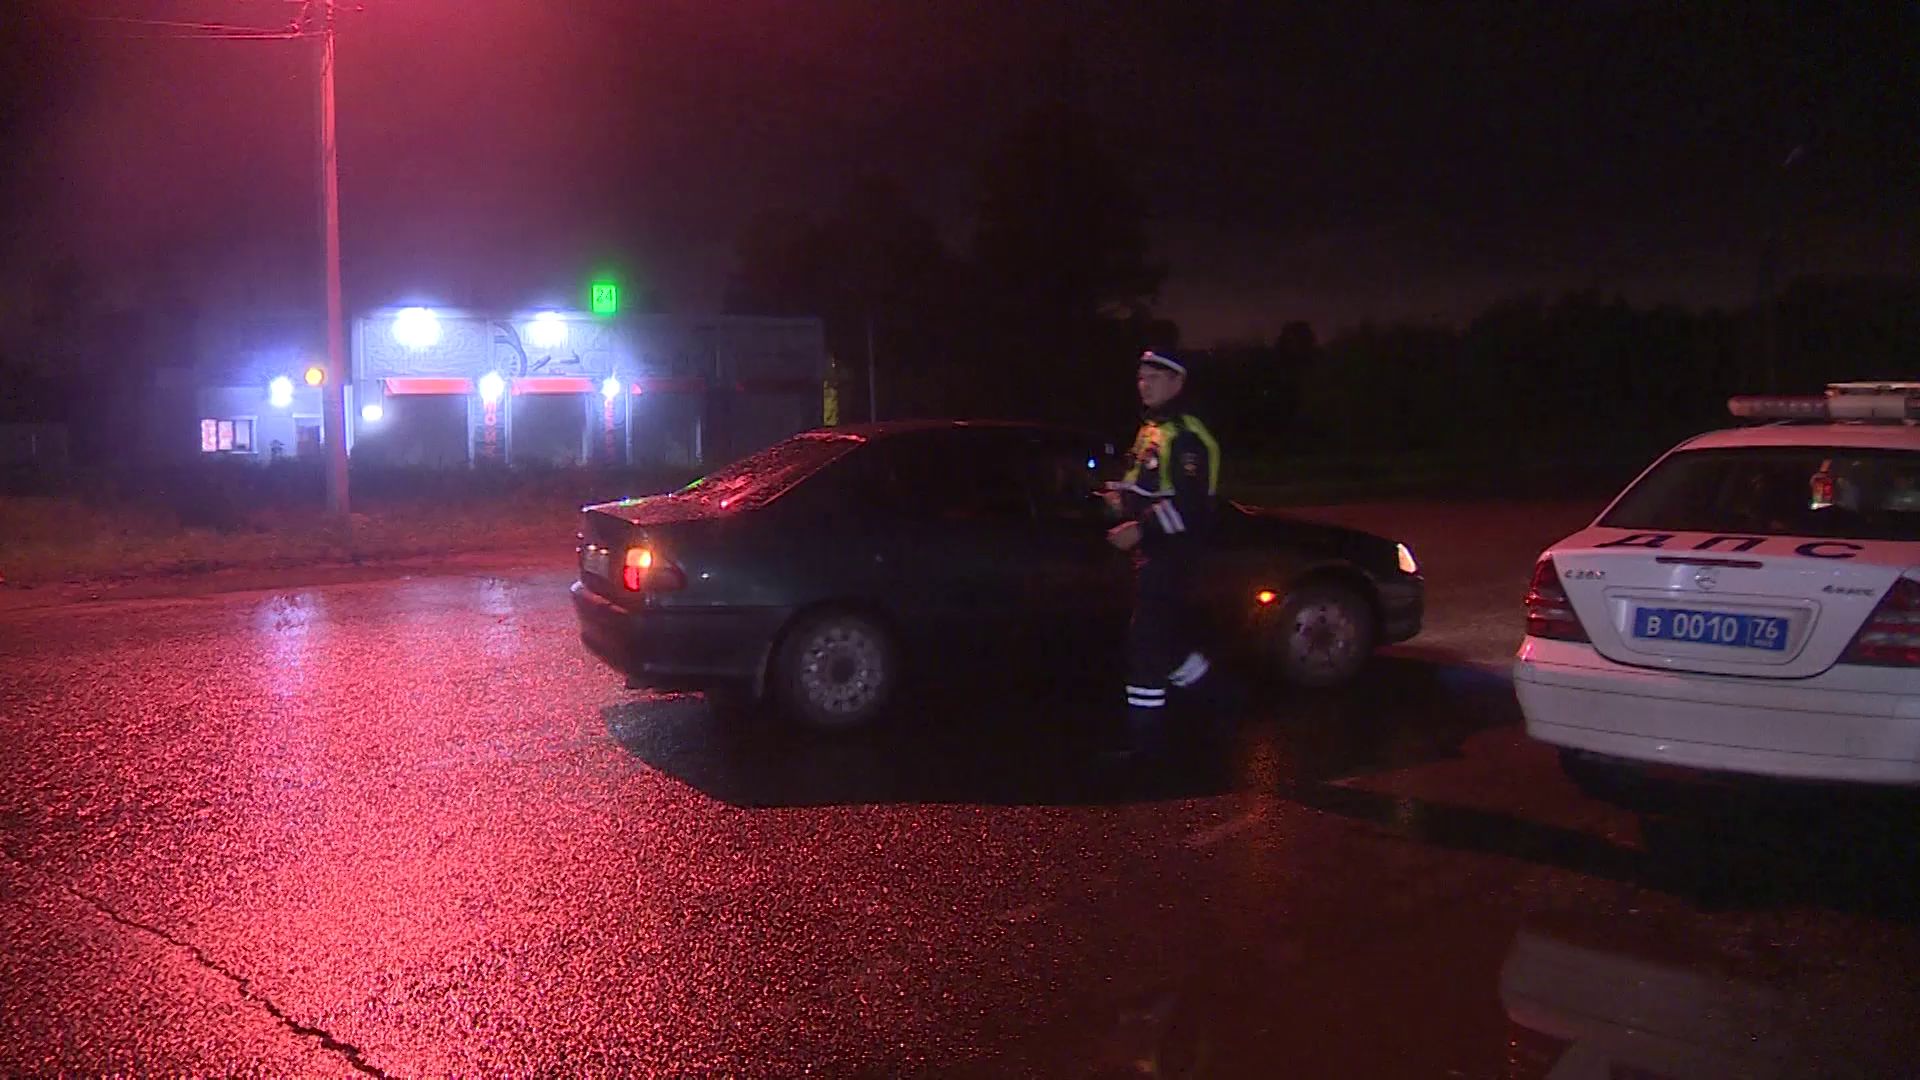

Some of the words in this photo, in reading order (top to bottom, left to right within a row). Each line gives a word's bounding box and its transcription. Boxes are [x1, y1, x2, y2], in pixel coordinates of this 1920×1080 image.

[596, 287, 613, 304] 24
[1593, 533, 1864, 559] ДПС
[1646, 615, 1662, 636] В
[1672, 613, 1738, 642] 0010
[1753, 618, 1779, 639] 76
